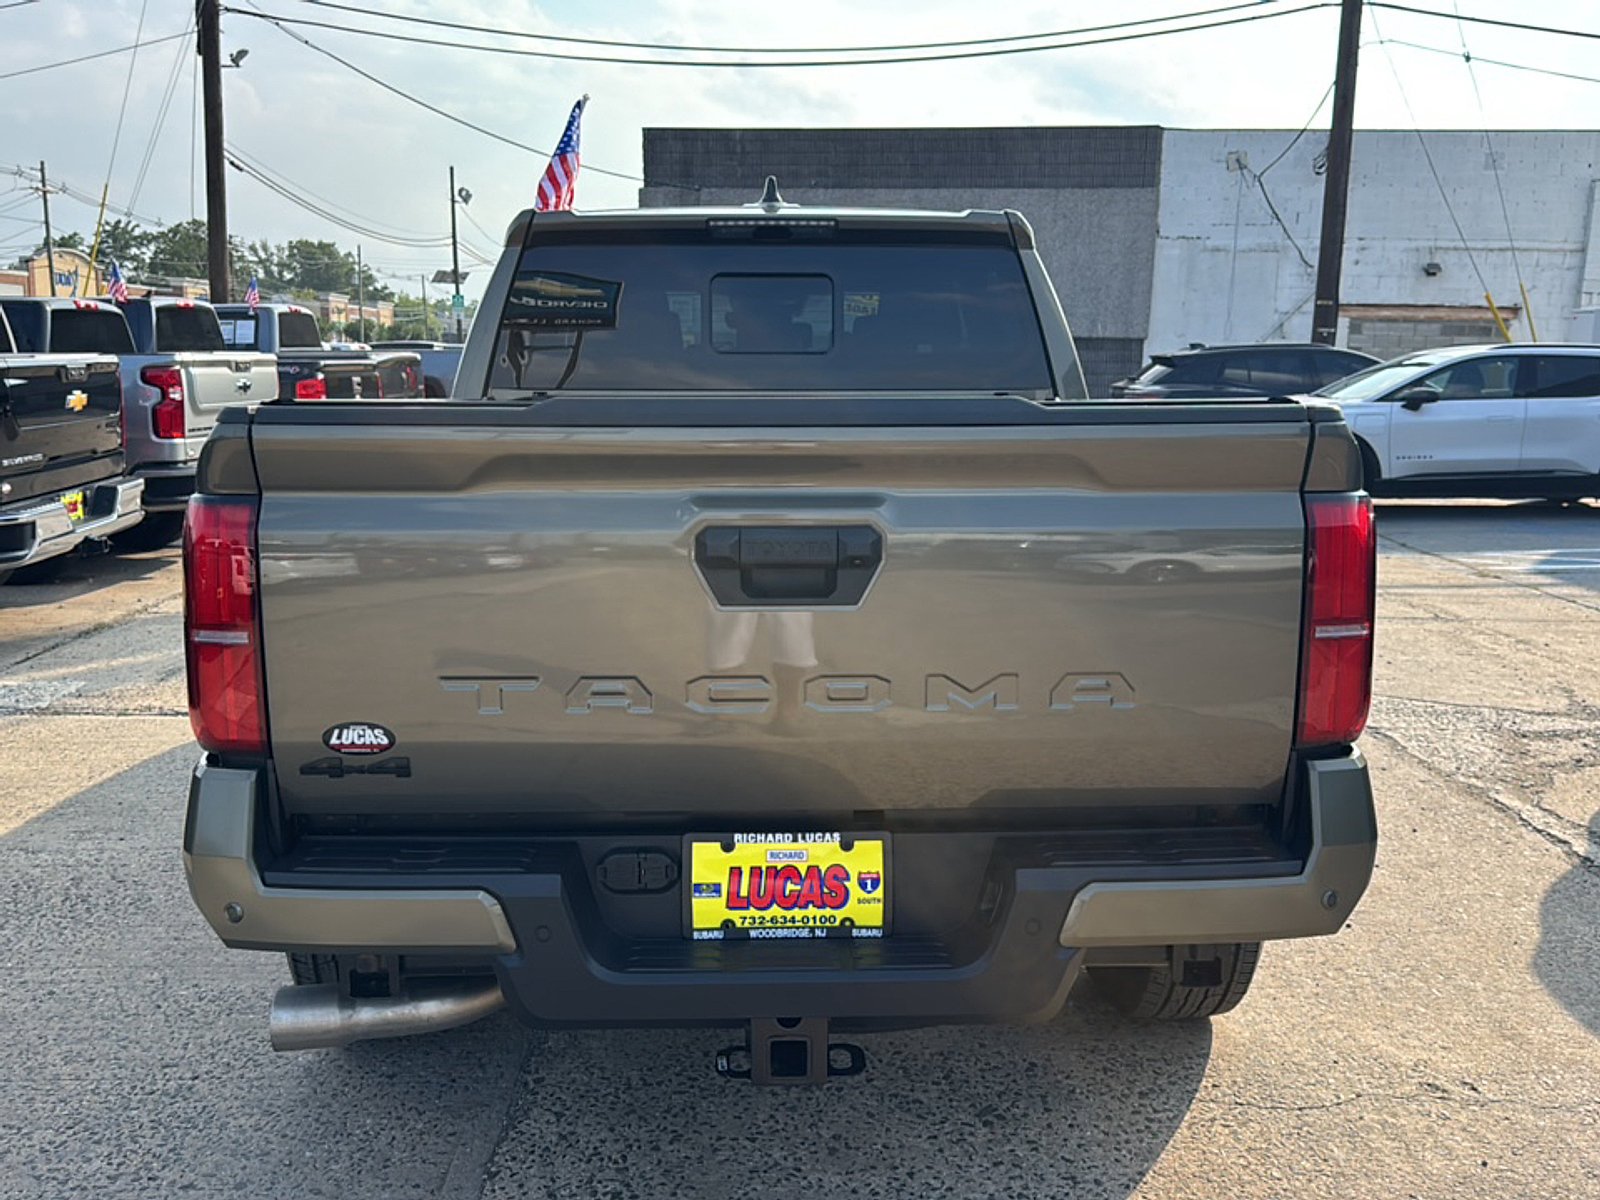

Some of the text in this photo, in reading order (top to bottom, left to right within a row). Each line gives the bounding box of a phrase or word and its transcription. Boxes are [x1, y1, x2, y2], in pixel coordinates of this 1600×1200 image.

[744, 541, 832, 557] TOYOTA
[439, 672, 1135, 714] TACOMA
[329, 728, 389, 745] LUCAS
[733, 832, 841, 844] RICHARD LUCAS
[769, 851, 805, 860] RICHARD
[726, 864, 850, 911] LUCAS
[864, 879, 873, 891] 1
[857, 897, 881, 905] SOUTH
[739, 915, 837, 926] 732-634-0100
[693, 930, 725, 940] SUBARU
[815, 928, 827, 937] NJ
[852, 928, 883, 938] SUBARU
